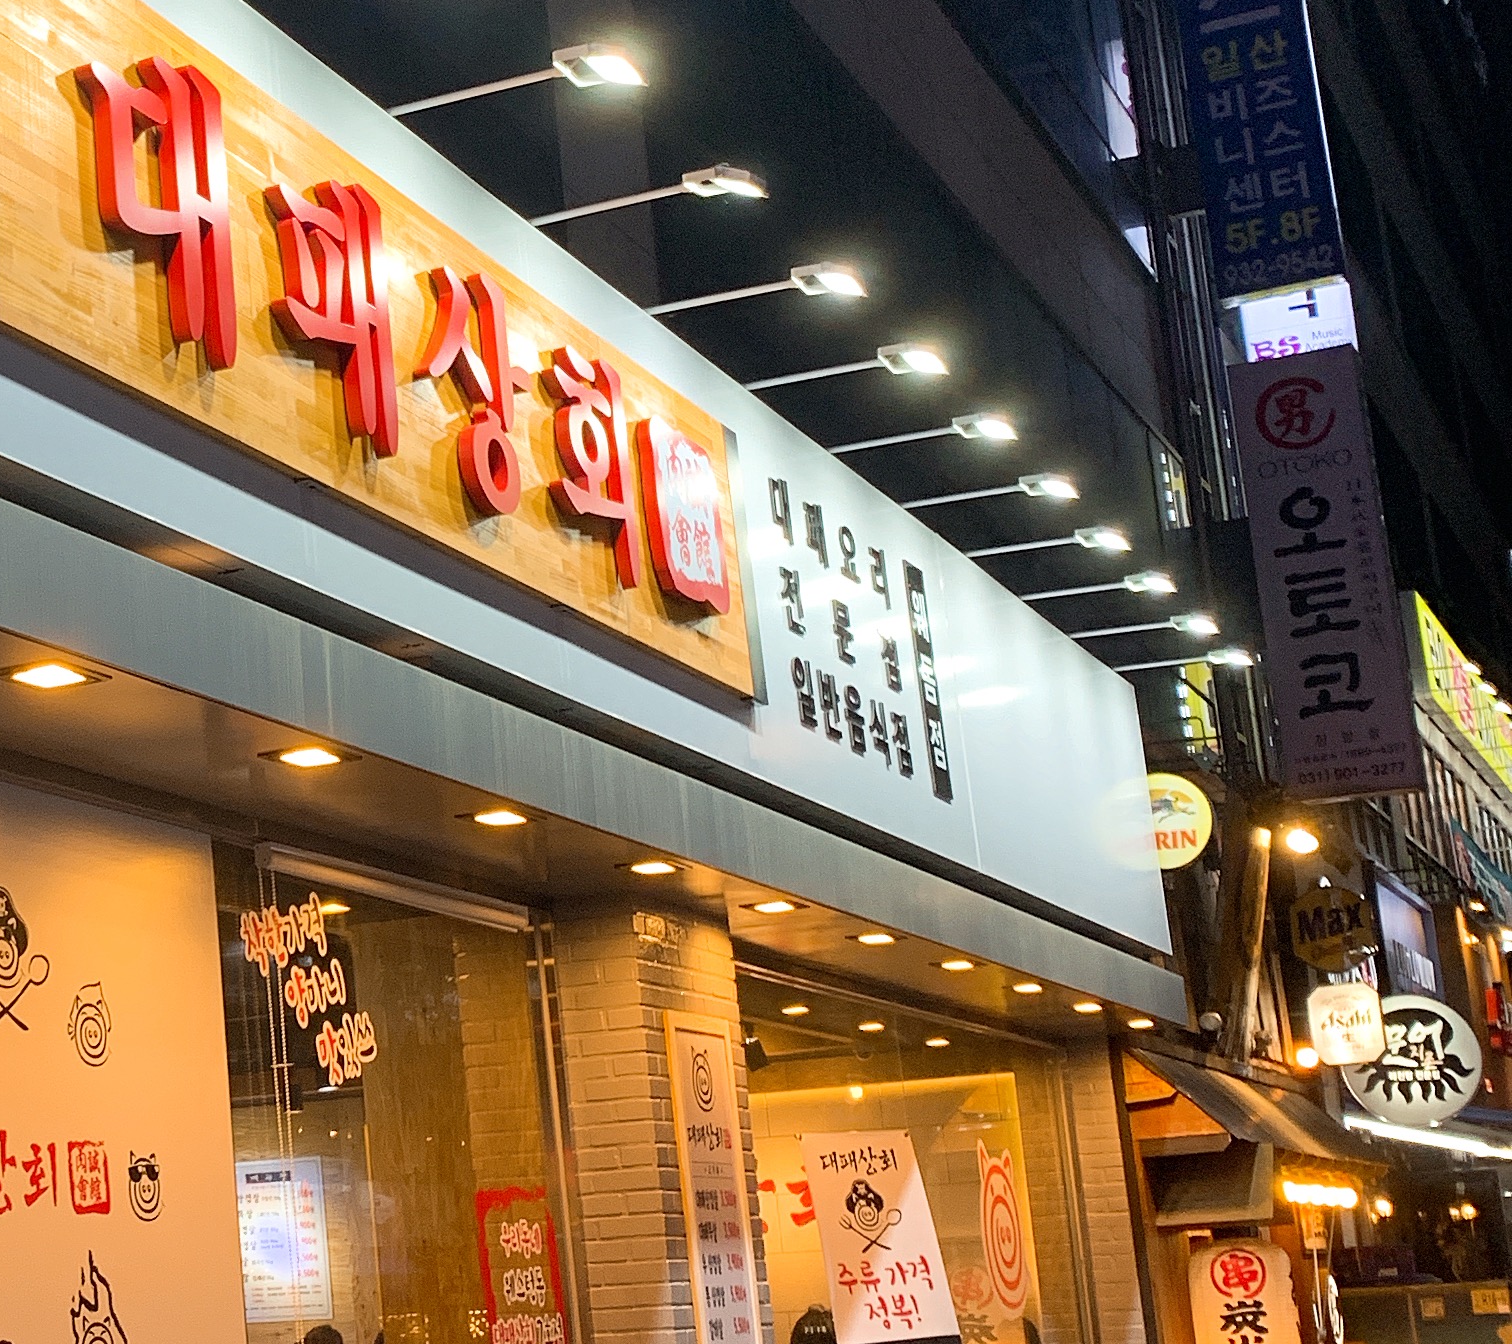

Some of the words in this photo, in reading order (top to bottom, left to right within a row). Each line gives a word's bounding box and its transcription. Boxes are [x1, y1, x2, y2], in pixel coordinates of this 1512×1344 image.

[74, 56, 640, 590] 대패상회
[1257, 448, 1353, 480] OTOKO
[768, 477, 891, 609] 대패요리
[1274, 486, 1375, 720] 오토코
[791, 656, 914, 779] 일반음식점
[1297, 901, 1363, 945] Max
[1321, 1009, 1372, 1031] Asahi
[820, 1146, 898, 1175] 대패상회
[838, 1261, 880, 1295] 주류
[885, 1255, 933, 1290] 가격
[865, 1295, 922, 1330] 정복!
